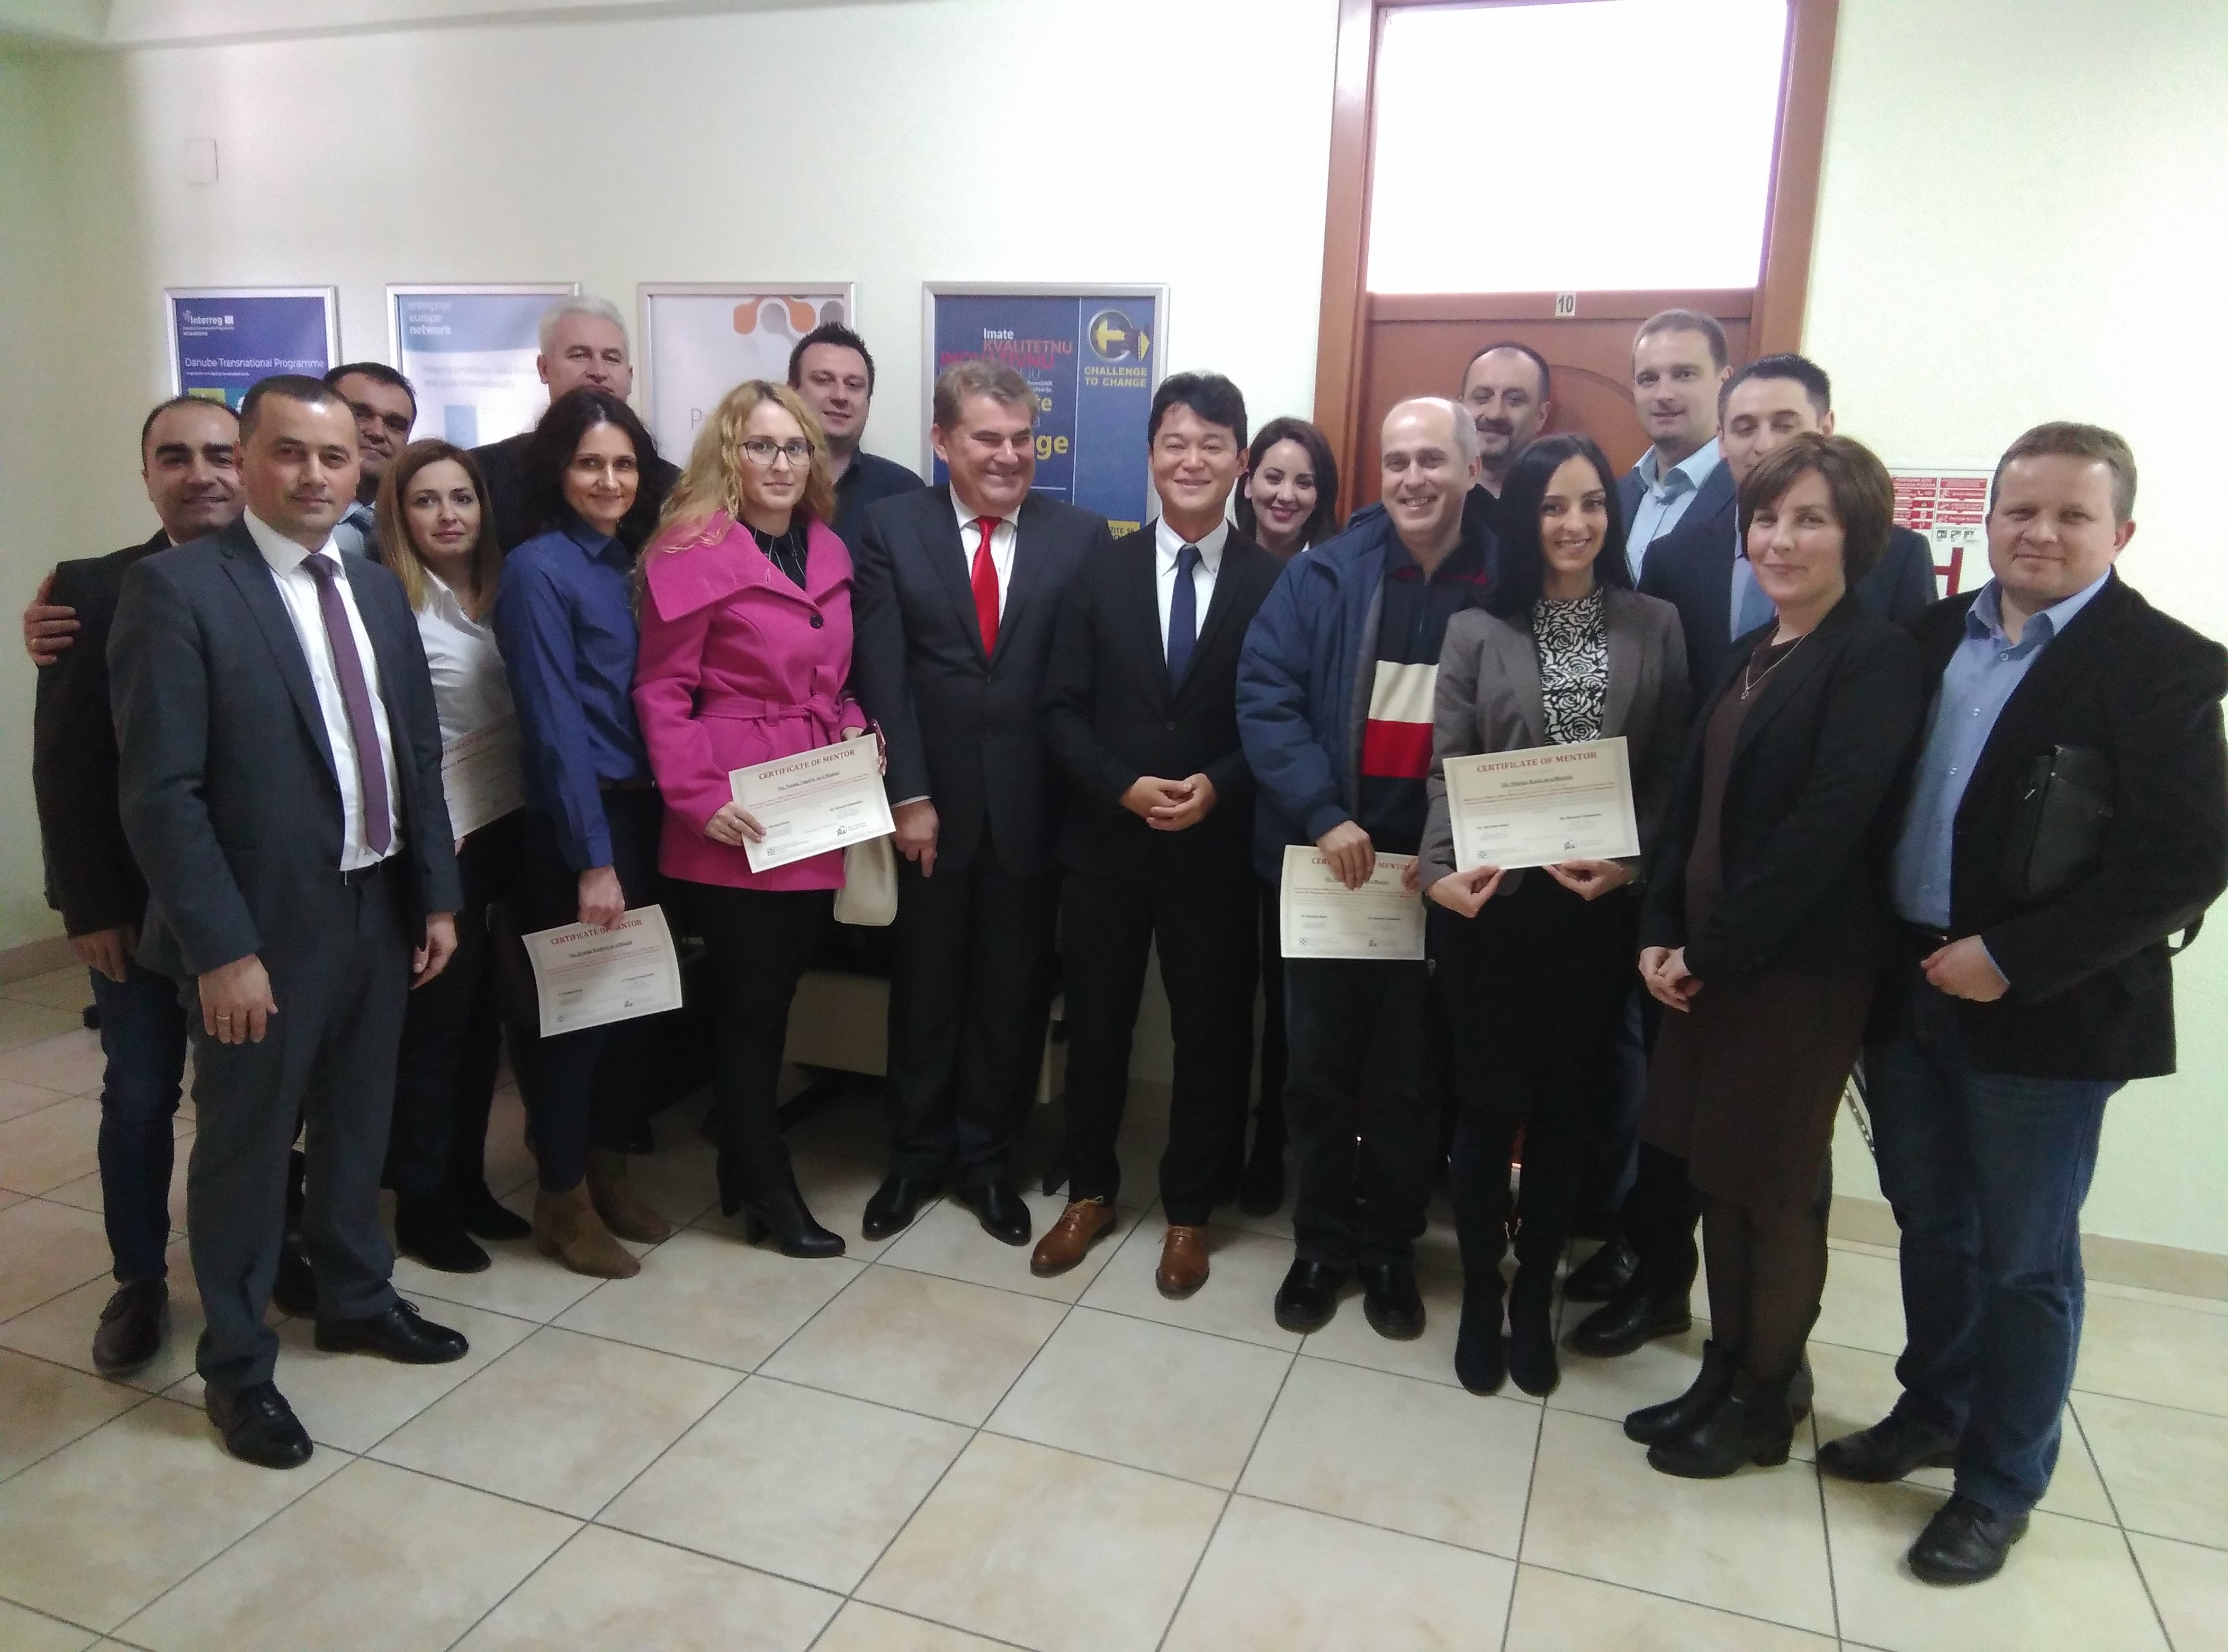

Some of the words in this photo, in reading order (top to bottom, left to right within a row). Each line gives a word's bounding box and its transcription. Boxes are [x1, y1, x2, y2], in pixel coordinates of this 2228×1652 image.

[1558, 295, 1574, 313] 10
[191, 316, 223, 326] Interreg
[410, 325, 451, 335] network
[983, 327, 1014, 340] Imate
[984, 339, 1073, 355] KVALITETNU
[185, 357, 218, 367] Danube
[219, 357, 272, 368] Transnational
[274, 358, 325, 369] Programme
[1084, 366, 1147, 375] CHALLENGE
[1085, 377, 1099, 385] TO
[1103, 378, 1147, 387] CHANGE
[759, 761, 810, 780] CERTIFICATE
[822, 749, 856, 762] MENTOR
[1477, 758, 1537, 773] CERTIFICATE
[1556, 751, 1598, 762] MENTOR
[551, 928, 598, 945] CERTIFICATE
